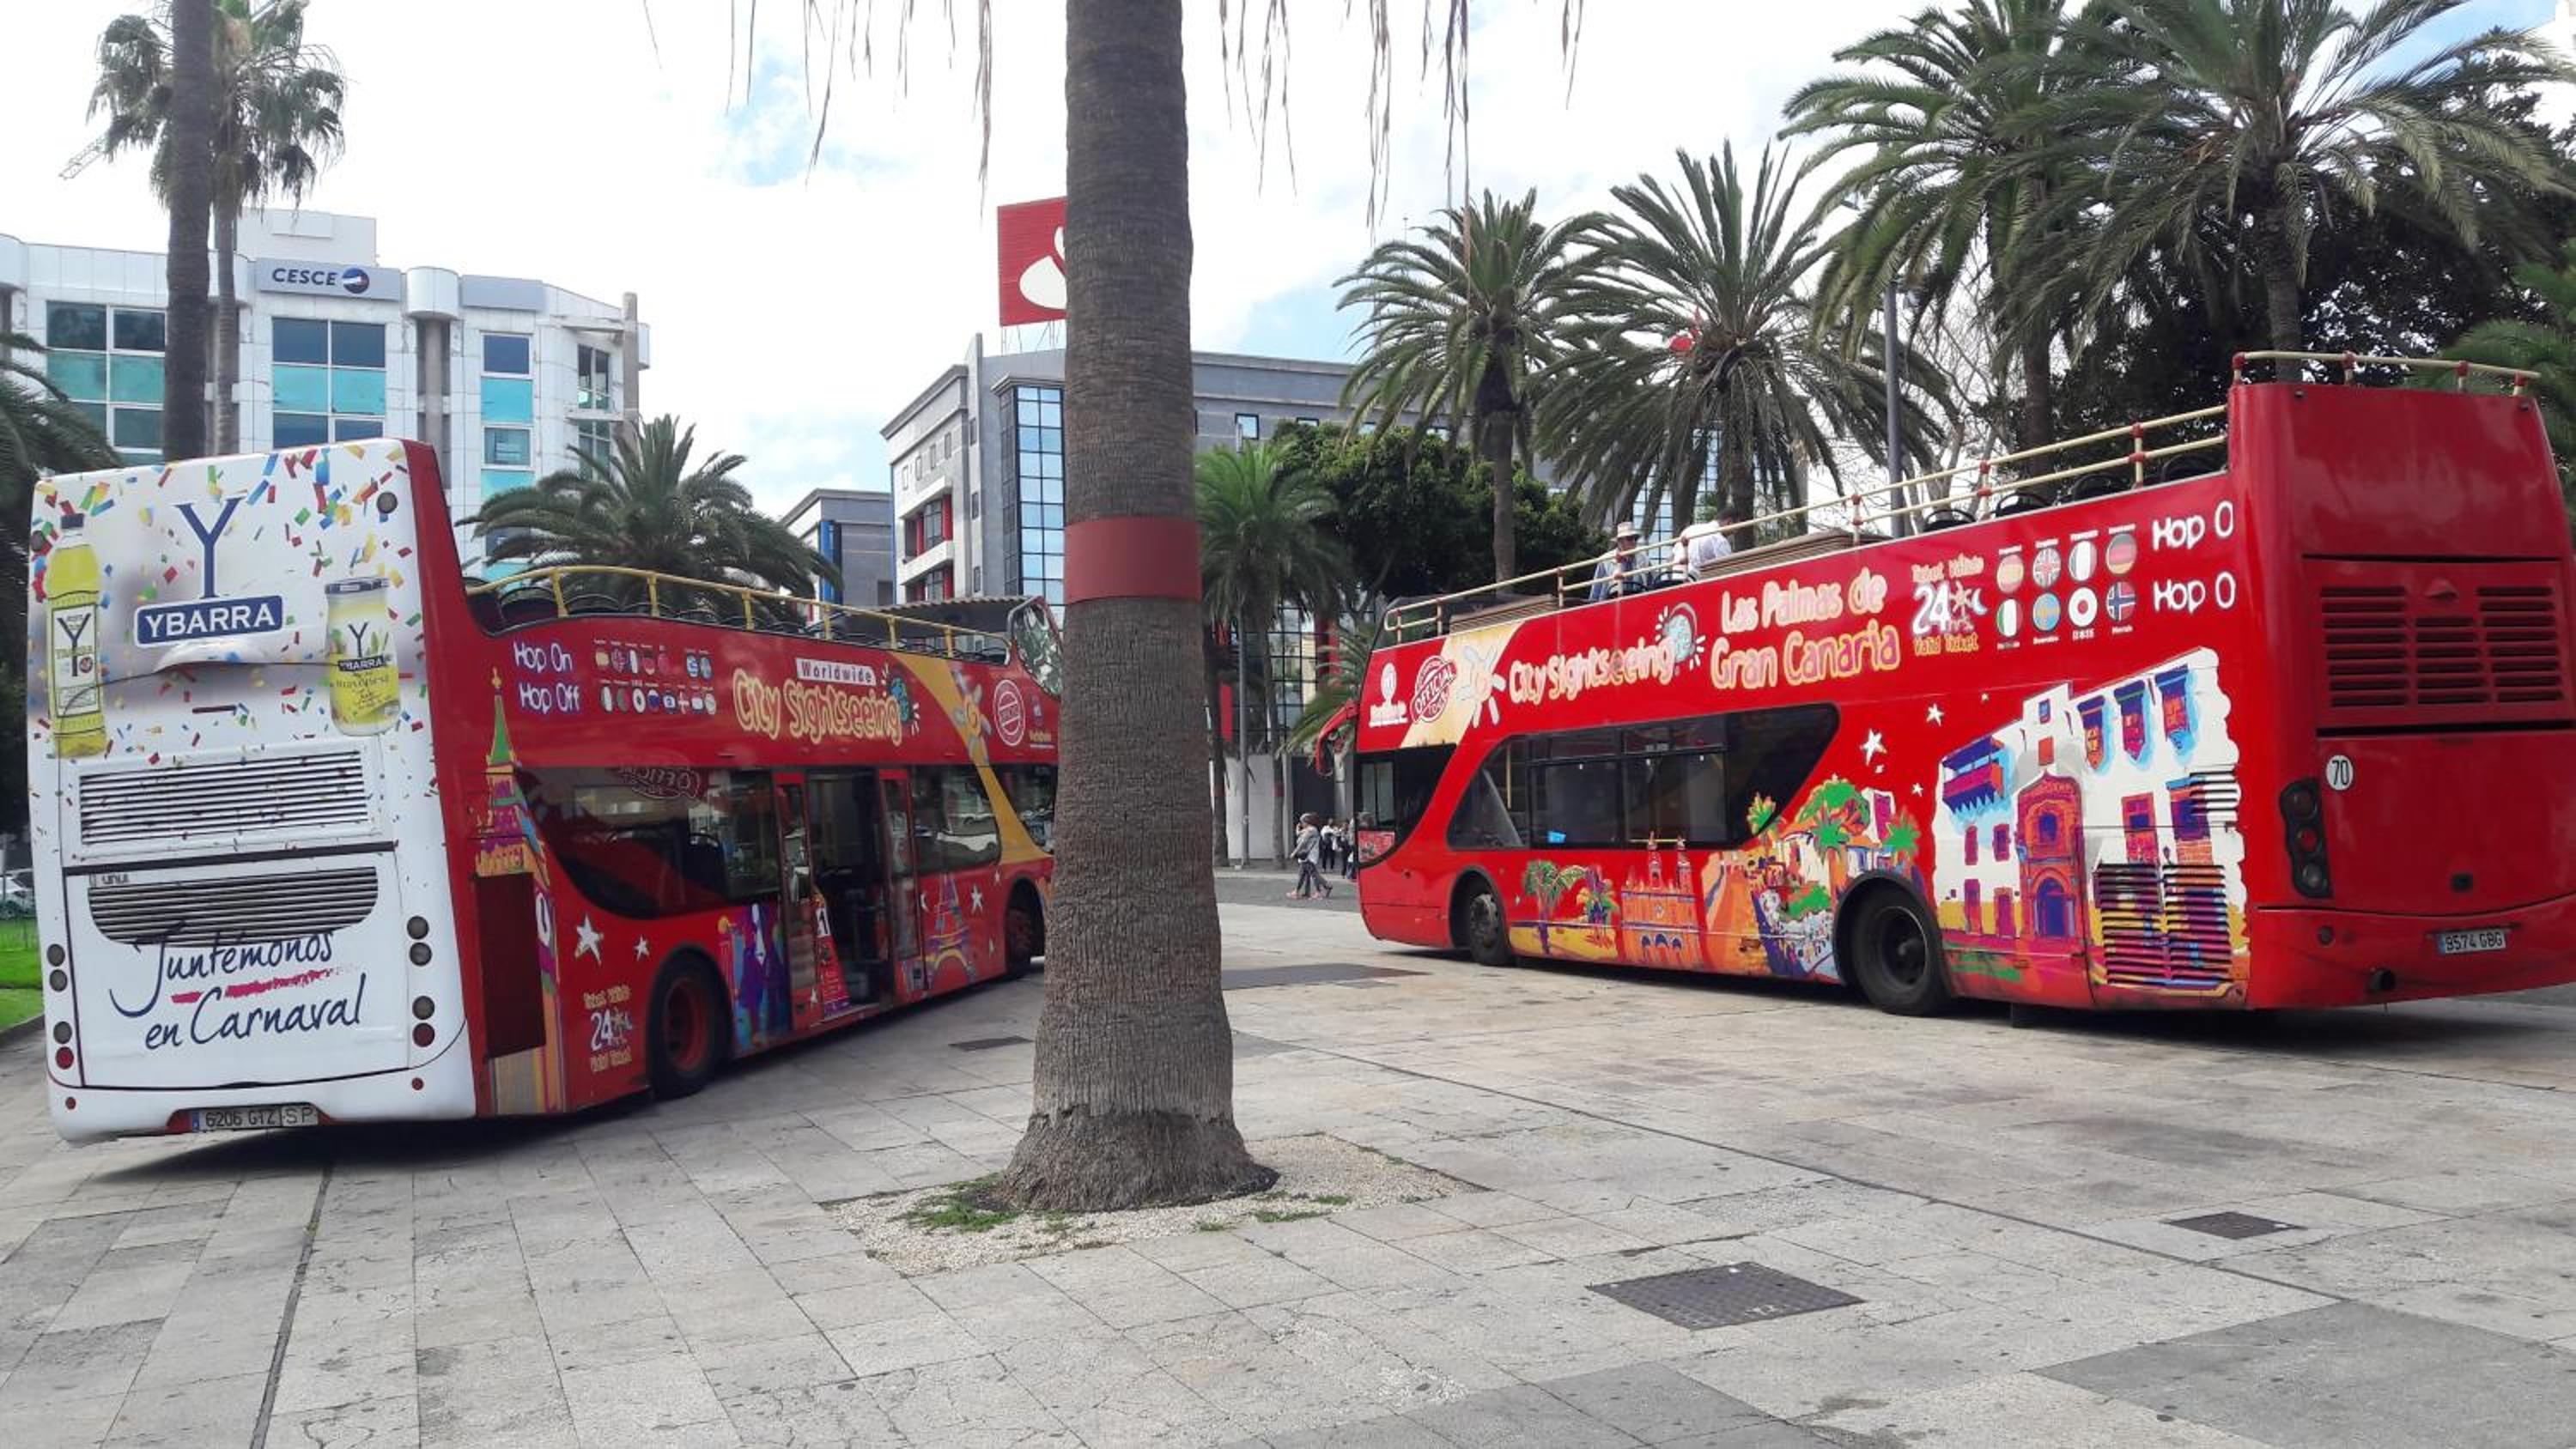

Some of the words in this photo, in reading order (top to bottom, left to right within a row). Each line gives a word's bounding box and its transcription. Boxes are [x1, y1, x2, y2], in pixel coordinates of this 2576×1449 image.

[272, 268, 337, 286] CESCE
[174, 495, 246, 599] Y
[2152, 514, 2206, 552] Hop
[1722, 590, 1759, 634] Las
[1761, 579, 1844, 628] Palmas
[1848, 566, 1888, 615] de
[1912, 581, 1951, 635] 24
[2153, 578, 2207, 615] Hop
[144, 602, 276, 639] YBARRA
[513, 641, 547, 673] Hop
[550, 642, 573, 672] On
[801, 661, 872, 683] Worldwide
[1509, 658, 1546, 706] City
[1547, 636, 1676, 701] Sightseeing
[1710, 636, 1778, 690] Gran
[1783, 617, 1901, 687] Canaria
[519, 682, 552, 715] Hop
[555, 682, 580, 712] Off
[732, 668, 781, 741] City
[783, 678, 903, 747] Sightseeing
[2331, 759, 2350, 785] 70
[2445, 934, 2477, 951] 9574
[2479, 931, 2504, 949] GBG
[144, 1023, 183, 1050] en
[190, 973, 367, 1045] Carnaval
[590, 1008, 614, 1052] 24
[205, 1112, 243, 1128] 6206
[248, 1109, 276, 1125] GTZ
